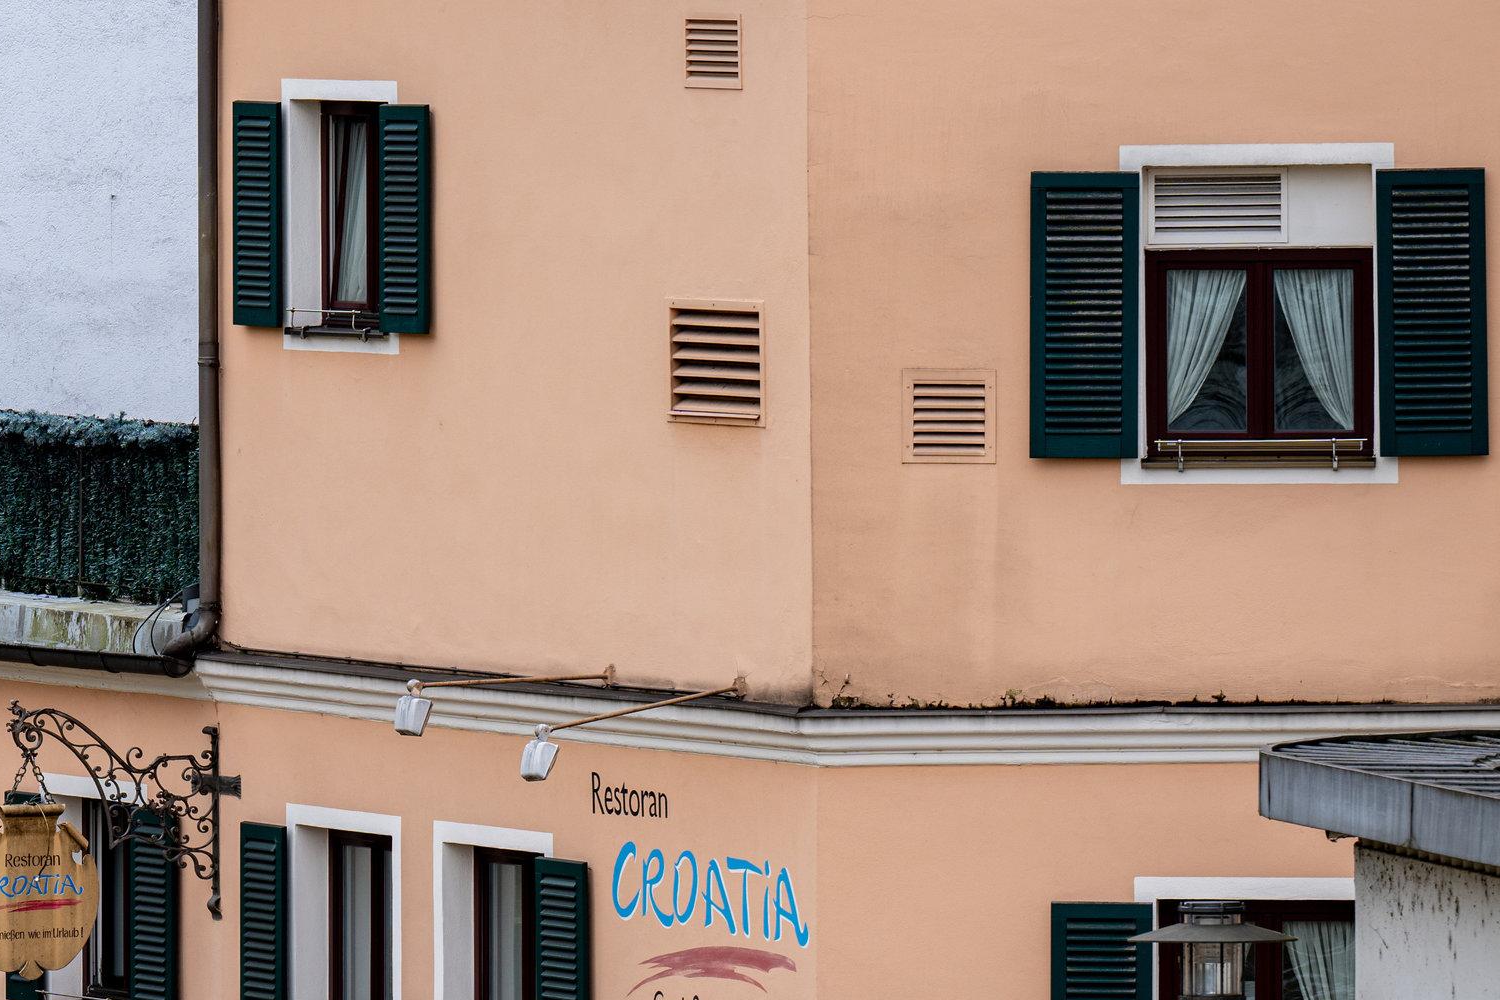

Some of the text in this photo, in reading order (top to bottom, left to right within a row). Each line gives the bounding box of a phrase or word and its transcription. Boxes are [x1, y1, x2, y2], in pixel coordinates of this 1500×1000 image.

[591, 771, 668, 818] Restoran
[5, 853, 61, 867] Restoran
[28, 929, 40, 939] wie
[43, 929, 52, 939] im
